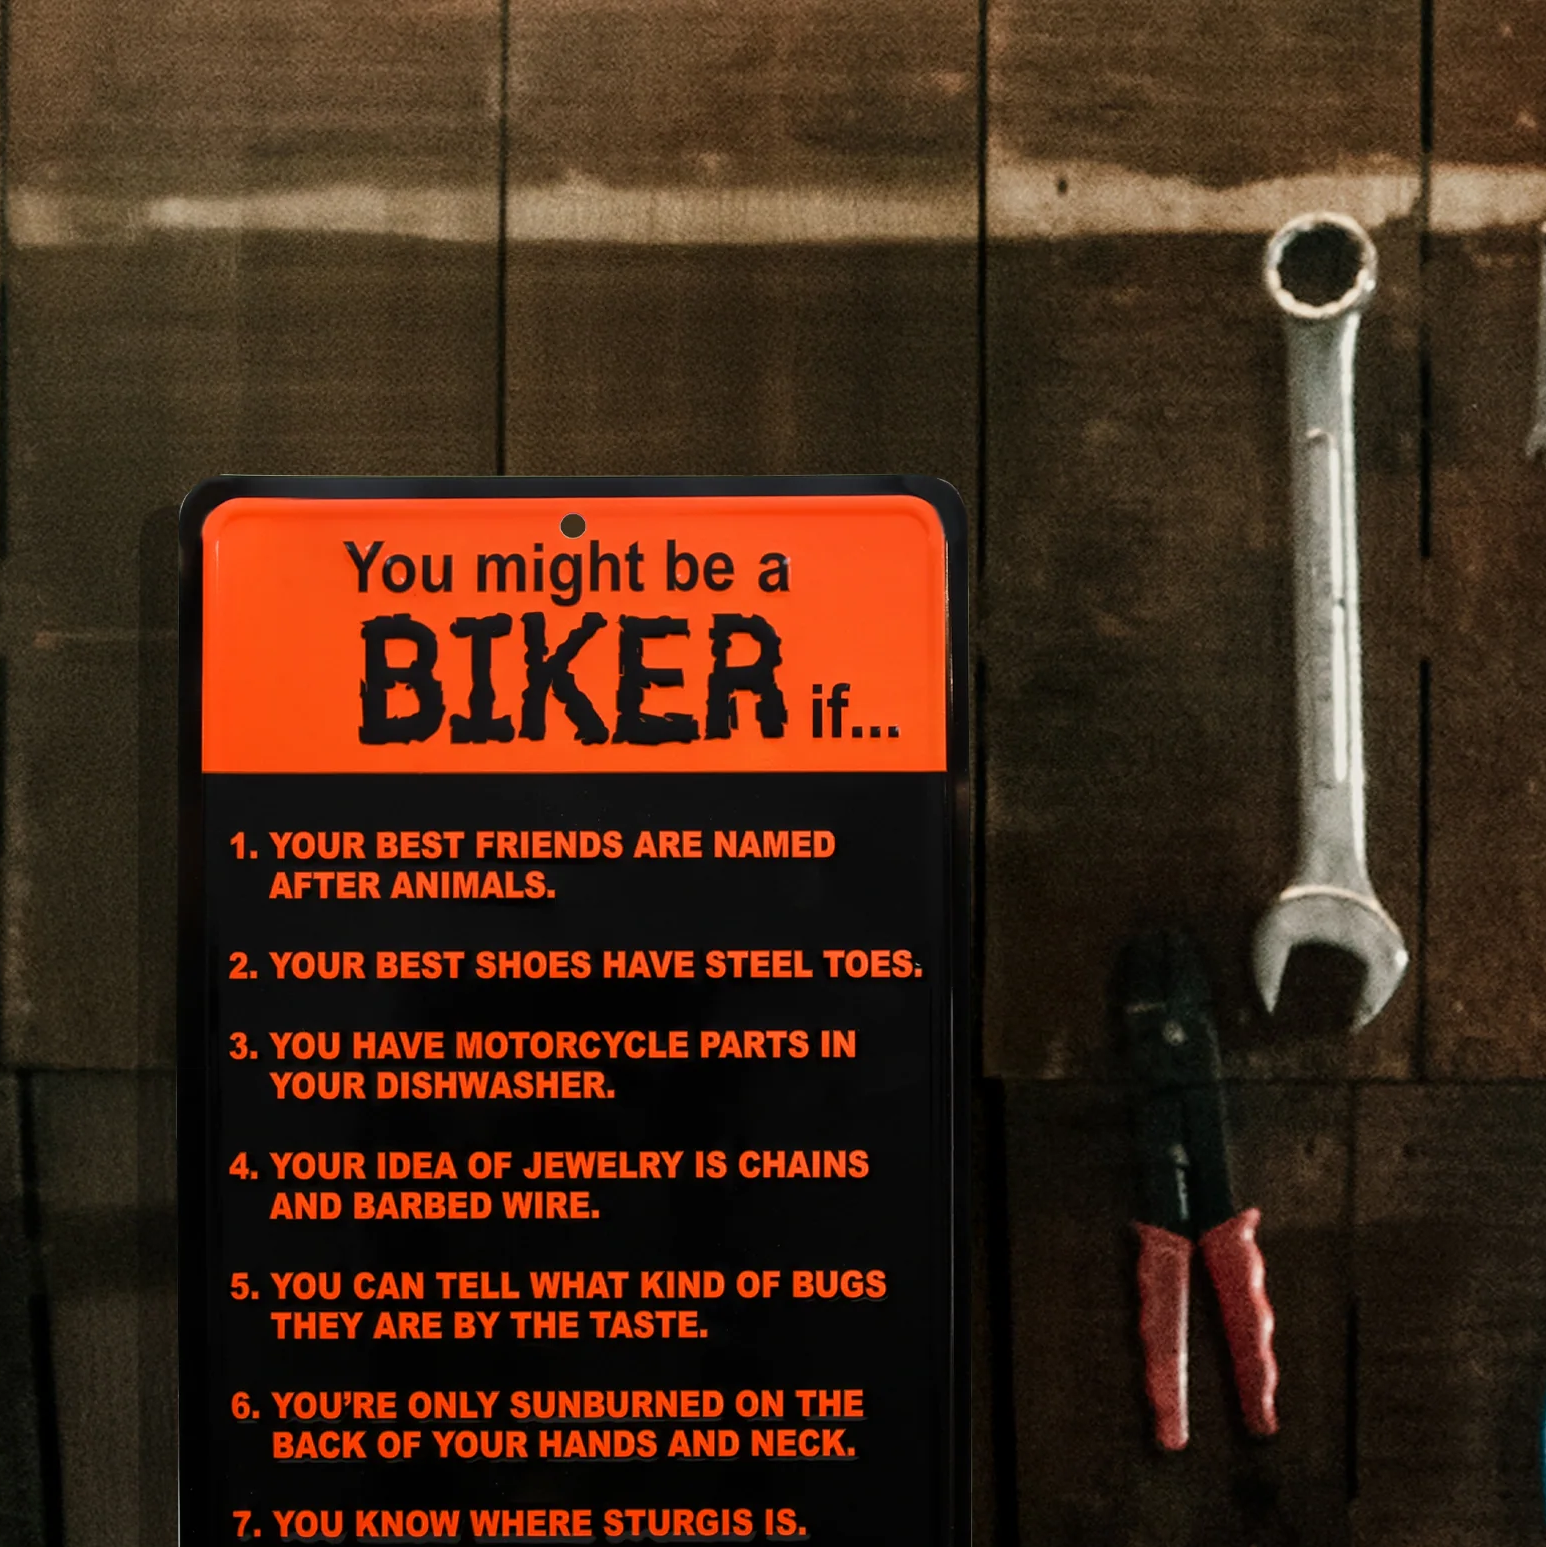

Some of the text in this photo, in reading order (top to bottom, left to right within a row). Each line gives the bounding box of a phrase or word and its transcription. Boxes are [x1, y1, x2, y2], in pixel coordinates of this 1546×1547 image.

[344, 540, 790, 606] You might be a
[359, 612, 900, 746] BIKER if...
[230, 829, 836, 860] 1. YOUR BEST FRIENDS ARE NAMED
[268, 870, 556, 900] AFTER ANIMALS.
[228, 949, 923, 980] 2. YOUR BEST SHOES HAVE STEEL TOES.
[229, 1029, 856, 1060] 3. YOU HAVE MOTORCYCLE PARTS IN
[269, 1070, 616, 1100] YOUR DISHWASHER.
[228, 1149, 870, 1180] 4. YOUR IDEA OF JEWELRY IS CHAINS
[269, 1191, 600, 1220] AND BARBED WIRE.
[230, 1269, 887, 1301] 5. YOU CAN TELL WHAT KIND OF BUGS
[270, 1310, 708, 1340] THEY ARE BY THE TASTE.
[231, 1389, 864, 1420] 6. YOU'RE ONLY SUNBURNED ON THE
[272, 1428, 856, 1459] BACK OF YOUR HANDS AND NECK.
[232, 1507, 807, 1538] 7. YOU KNOW WHERE STURGIS IS.
